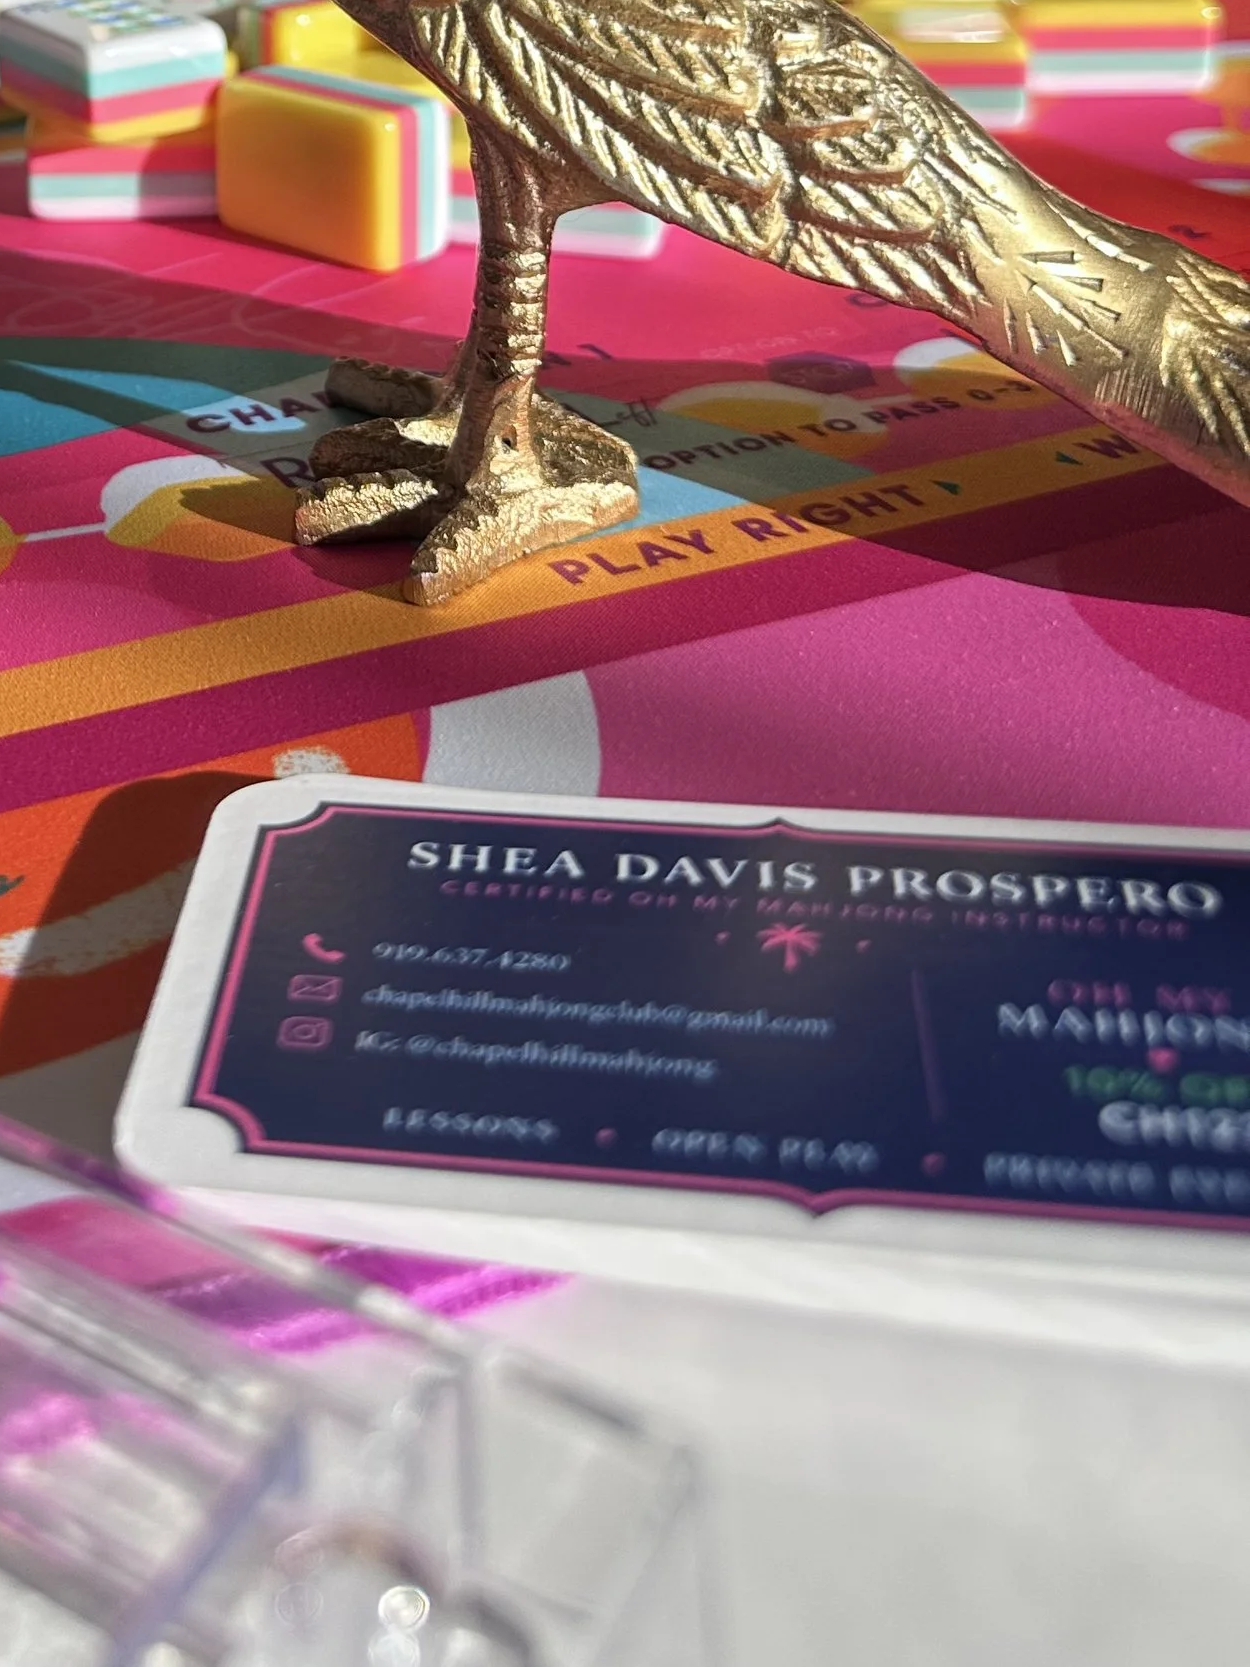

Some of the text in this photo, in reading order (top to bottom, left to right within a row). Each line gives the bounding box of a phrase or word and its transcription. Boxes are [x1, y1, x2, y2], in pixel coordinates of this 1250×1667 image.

[642, 431, 797, 471] OPTION
[798, 417, 857, 439] TO
[866, 397, 959, 426] PASS
[547, 482, 927, 587] PLAY RIGHT
[406, 841, 1222, 919] SHEA DAVIS PROSPERO
[439, 879, 1191, 940] CERTIFIED OH MY MAHJONG INSTRUCTOR
[371, 942, 572, 972] 919.637.4280
[997, 1001, 1250, 1054] MAHJON
[382, 1105, 558, 1143] LESSONS
[652, 1126, 765, 1164] OPEN
